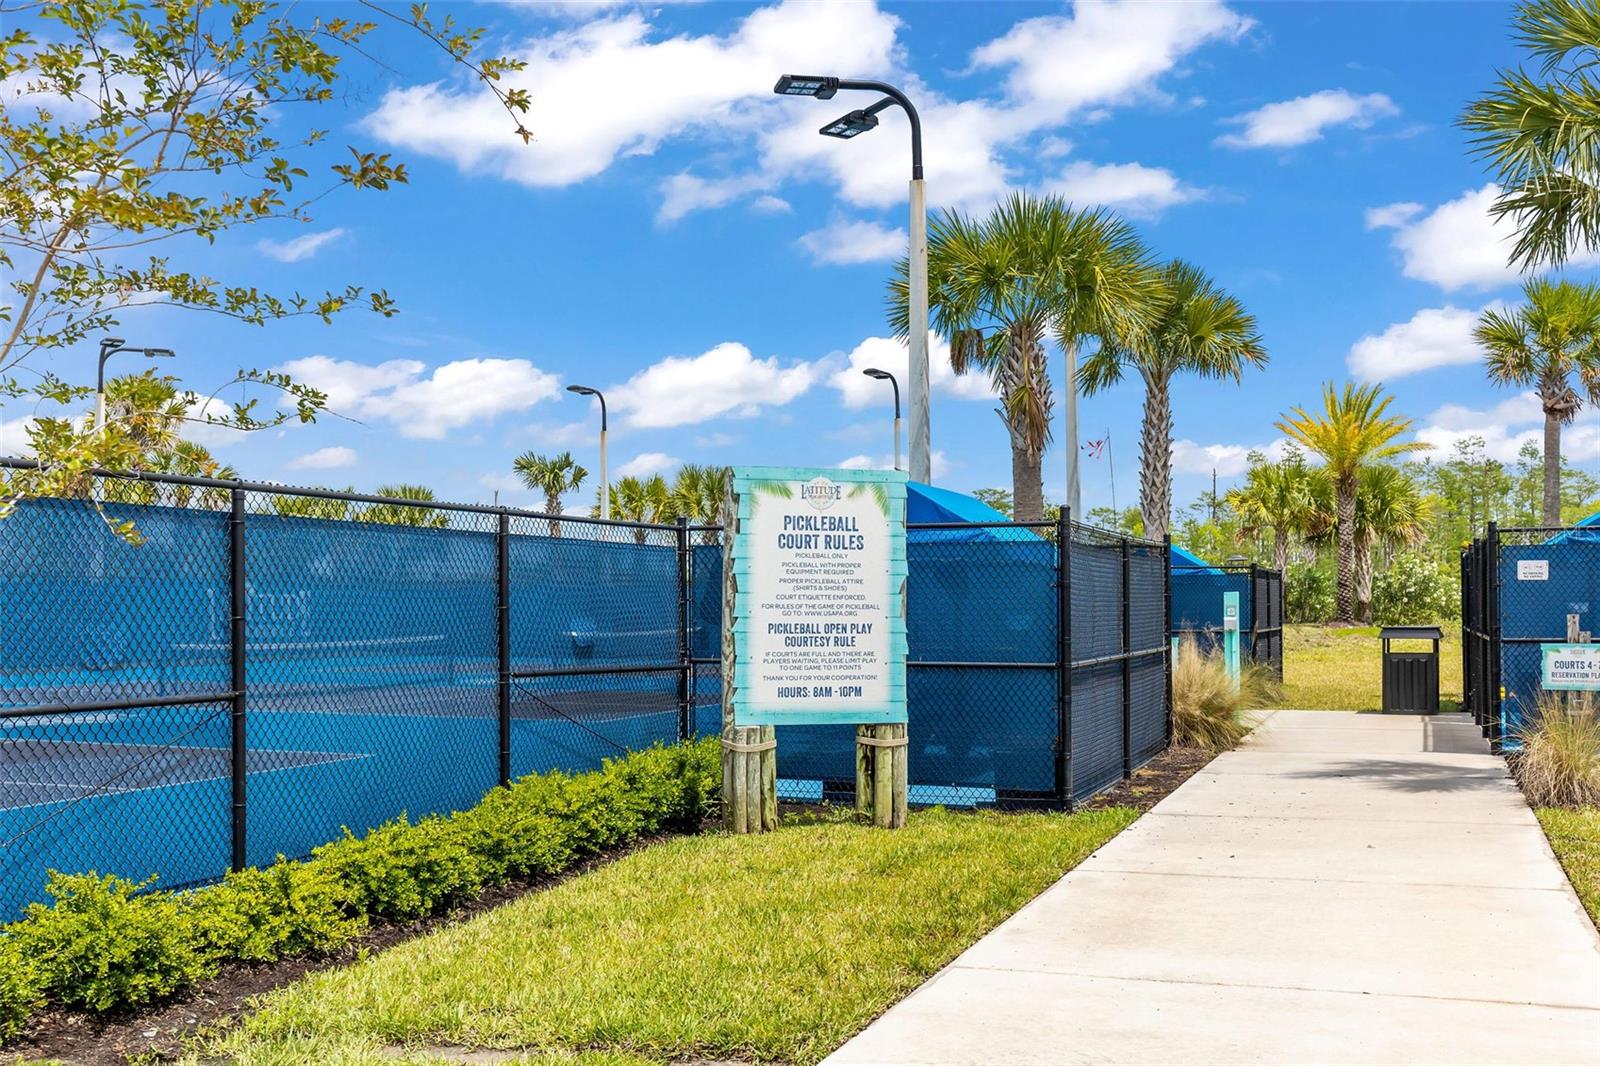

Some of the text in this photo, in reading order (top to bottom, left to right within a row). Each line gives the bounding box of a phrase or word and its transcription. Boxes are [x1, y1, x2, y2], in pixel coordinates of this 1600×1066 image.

[784, 515, 859, 532] PICKLEBALL
[778, 533, 864, 550] COURT RULES
[768, 623, 873, 635] PICKLEBALL OPEN PLAY
[784, 635, 856, 647] COURTESY RULE
[1554, 660, 1585, 670] COURTS
[1551, 671, 1589, 679] RESERVATION
[777, 686, 810, 698] HOURS:
[813, 686, 832, 698] 8AM
